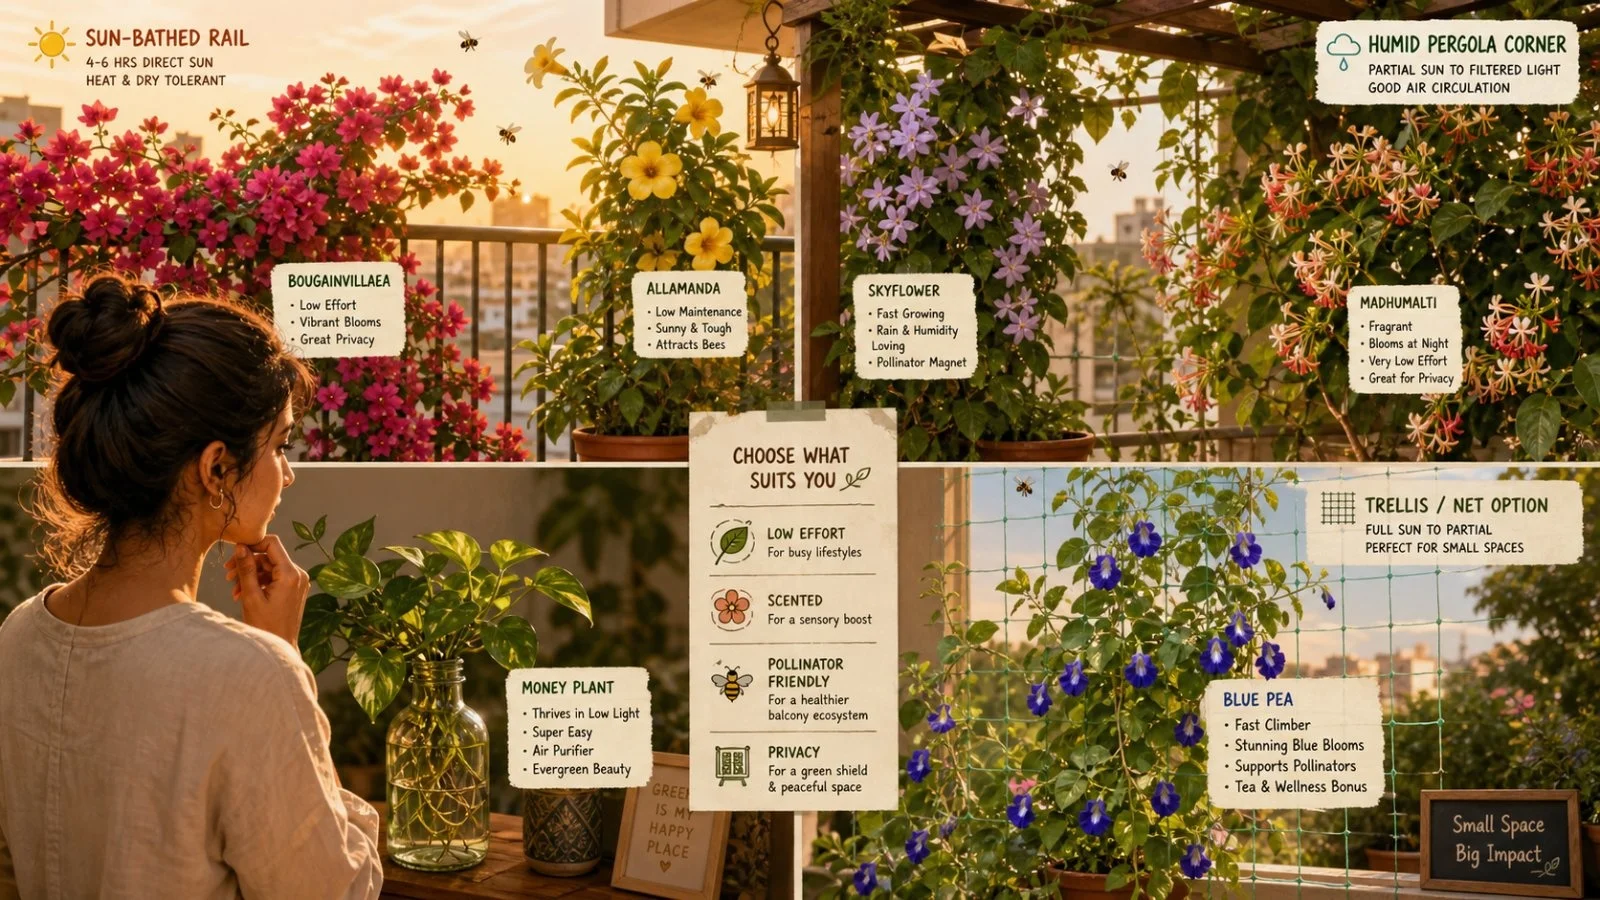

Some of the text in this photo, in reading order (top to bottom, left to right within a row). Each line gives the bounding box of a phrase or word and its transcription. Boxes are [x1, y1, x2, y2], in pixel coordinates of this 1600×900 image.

[652, 783, 689, 800] GREE
[655, 803, 694, 821] IS MY
[647, 821, 695, 841] HAPPY
[1452, 814, 1545, 839] Small Space
[646, 839, 690, 859] PLACE
[1455, 843, 1542, 868] Big Impact
